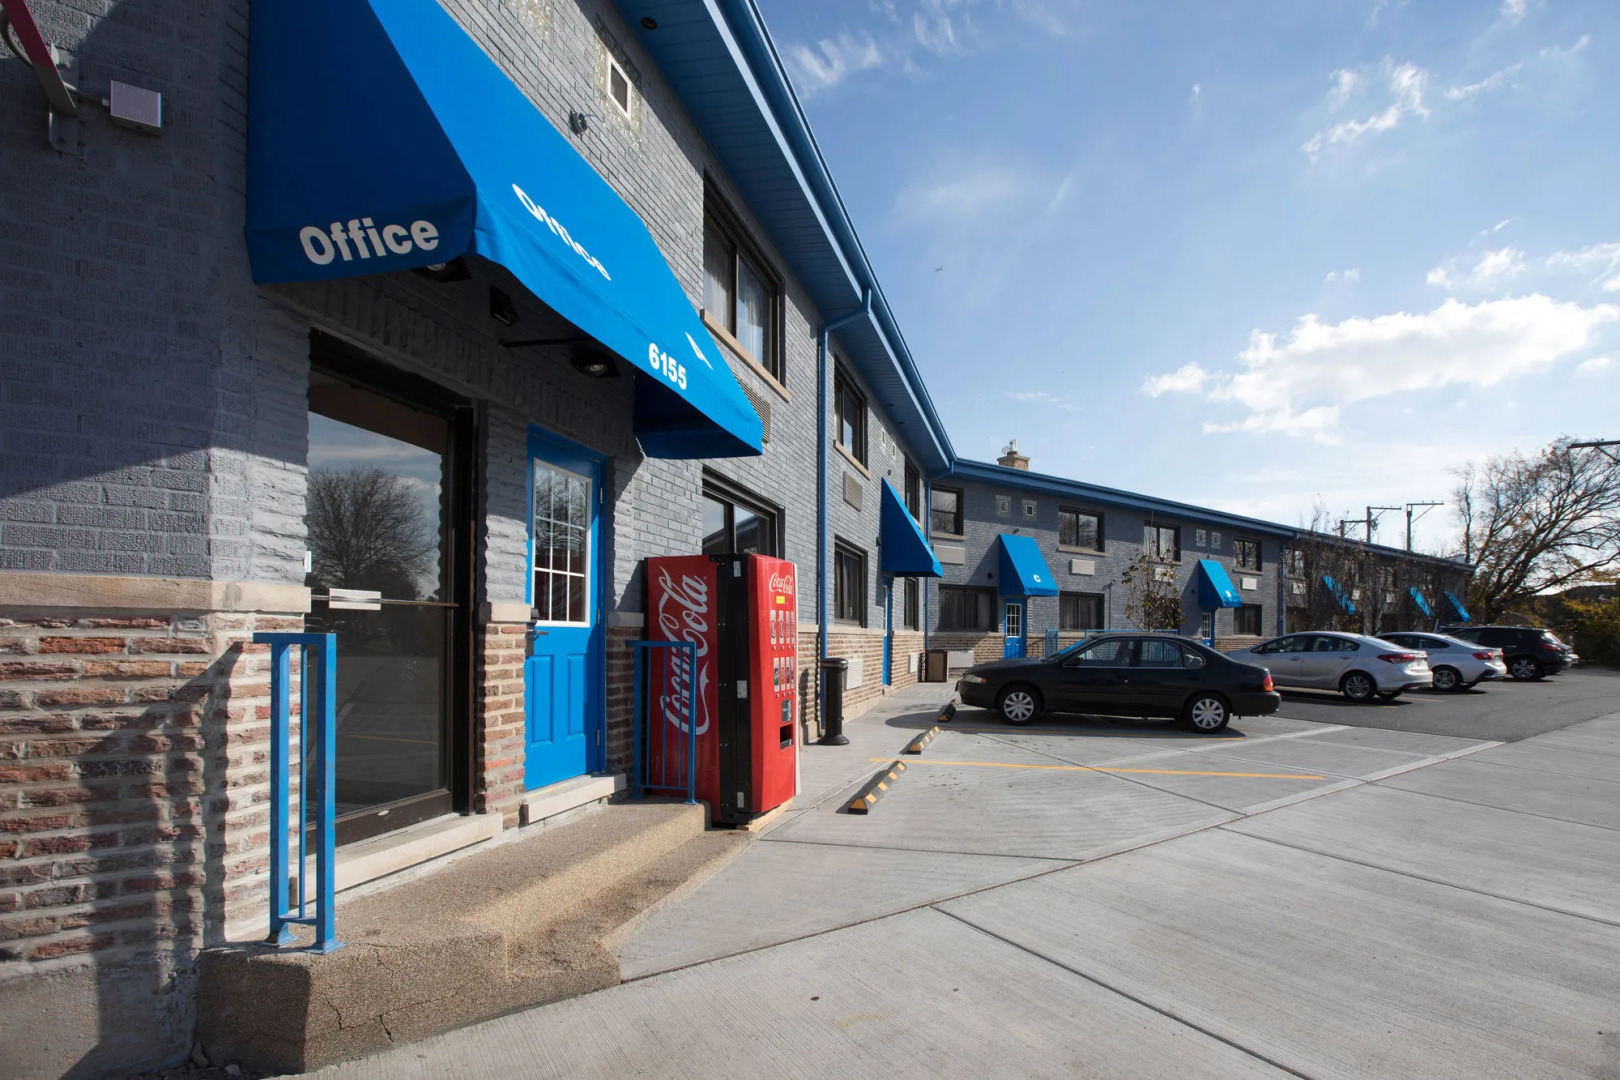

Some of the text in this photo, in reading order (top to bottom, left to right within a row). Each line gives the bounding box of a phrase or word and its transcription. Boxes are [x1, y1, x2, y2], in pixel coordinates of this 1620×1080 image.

[299, 217, 439, 265] Office
[512, 183, 612, 281] Office
[648, 342, 687, 390] 6155
